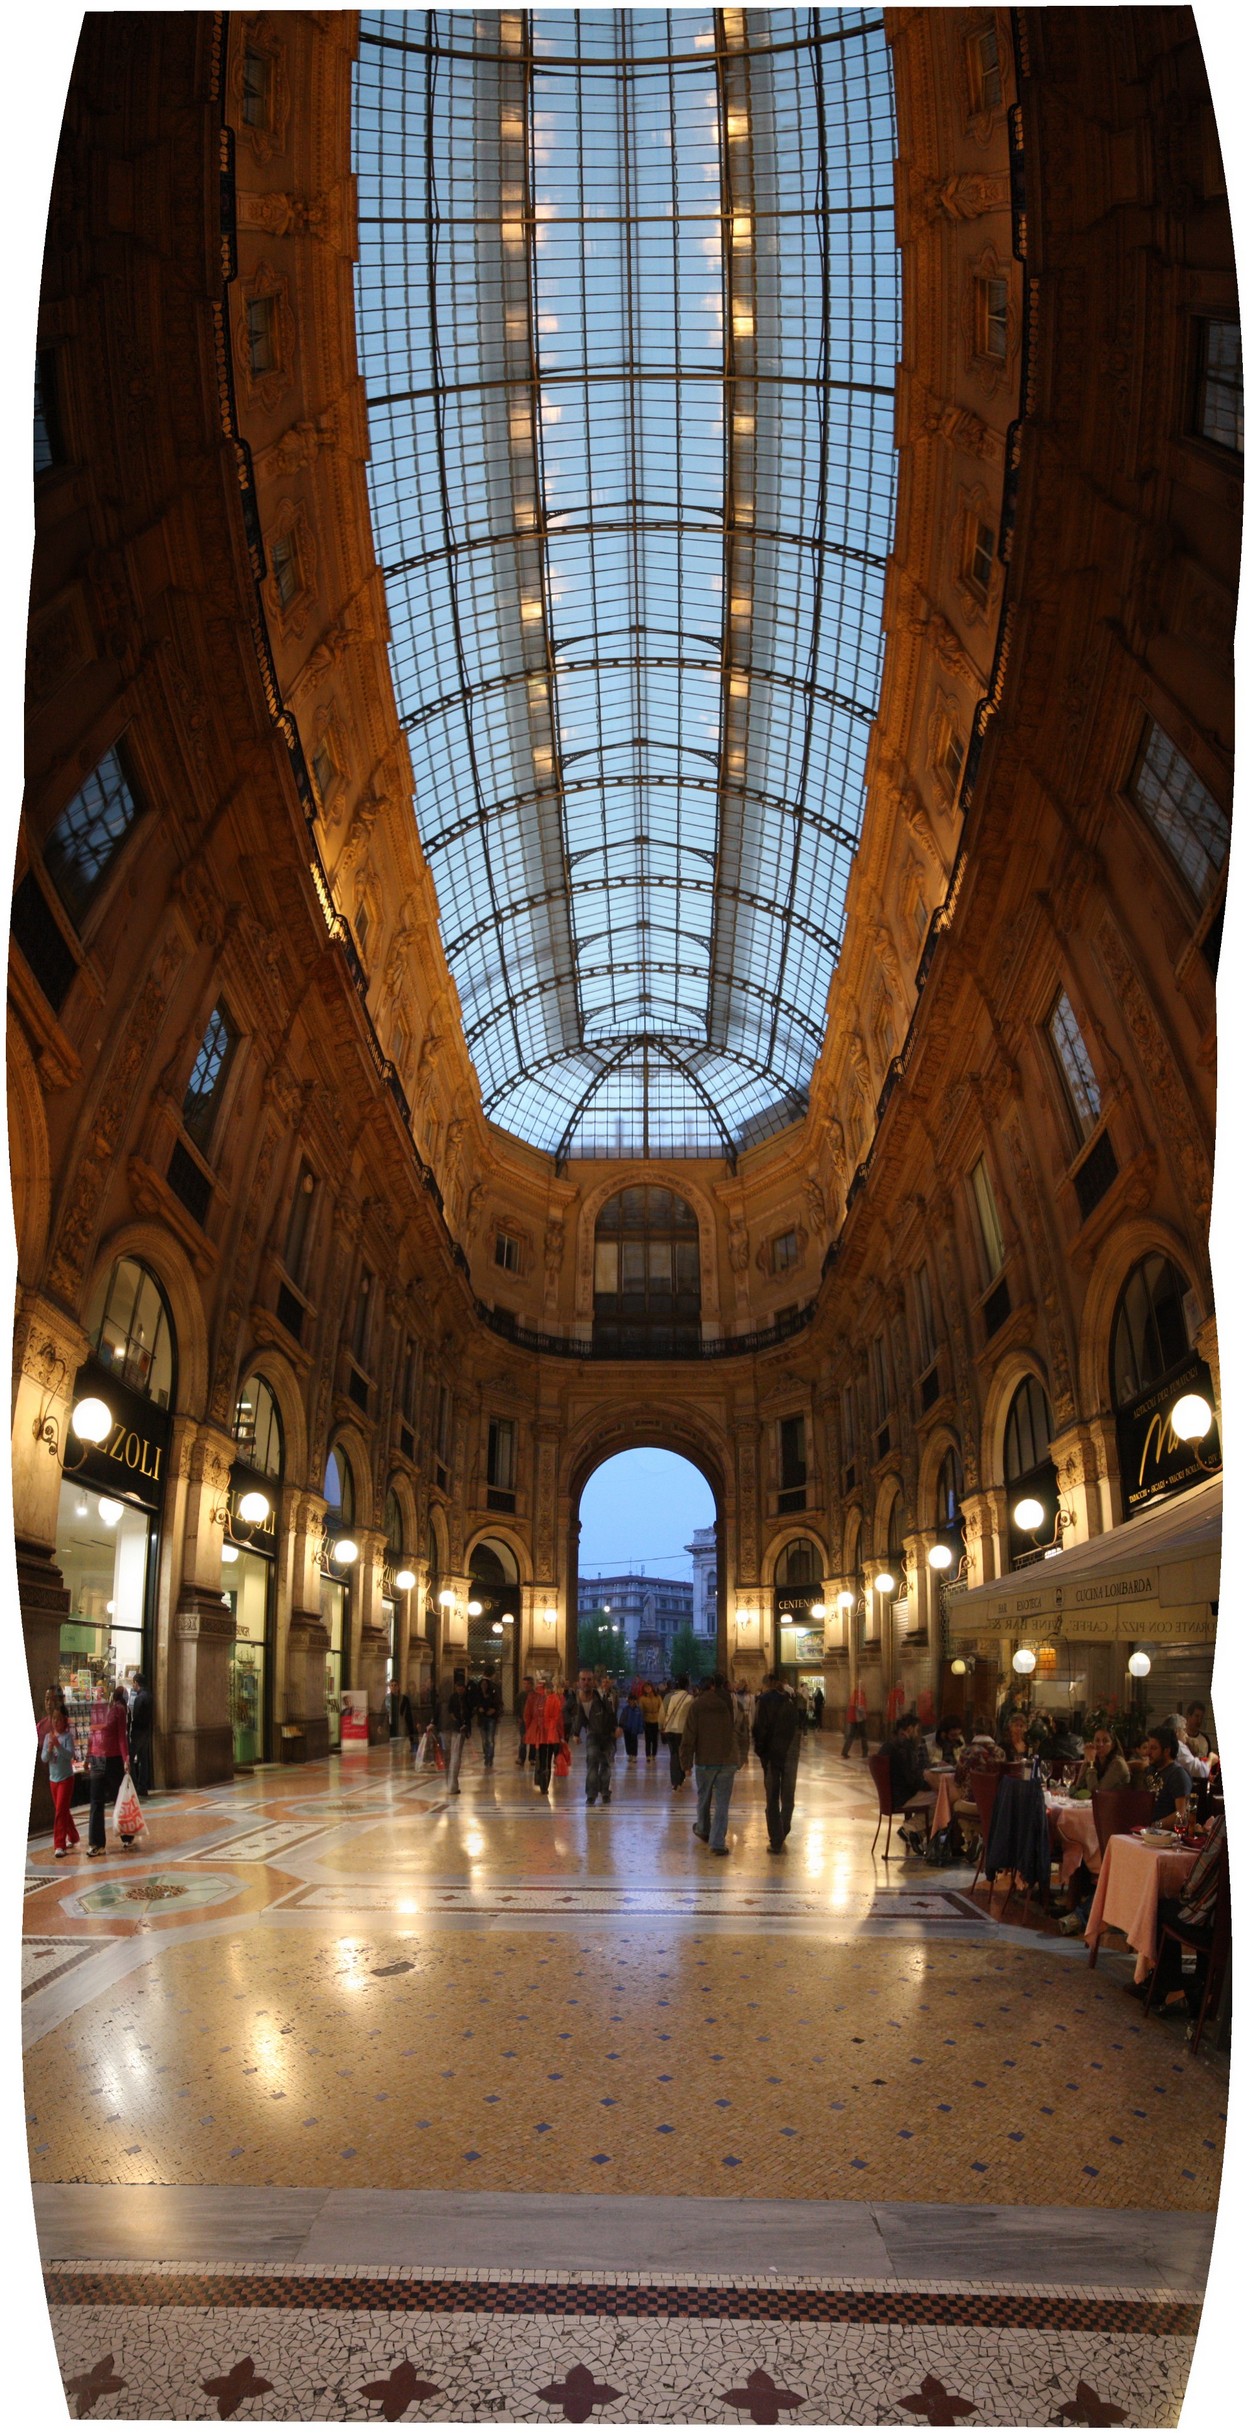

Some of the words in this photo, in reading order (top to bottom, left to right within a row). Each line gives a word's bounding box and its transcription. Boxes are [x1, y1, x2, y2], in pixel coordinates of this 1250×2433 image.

[93, 1422, 162, 1481] ZOLI
[998, 1603, 1008, 1614] BAR
[1016, 1596, 1042, 1612] ENOTECA
[1076, 1586, 1103, 1602] CUCINA
[1105, 1578, 1153, 1598] LOMBARDA
